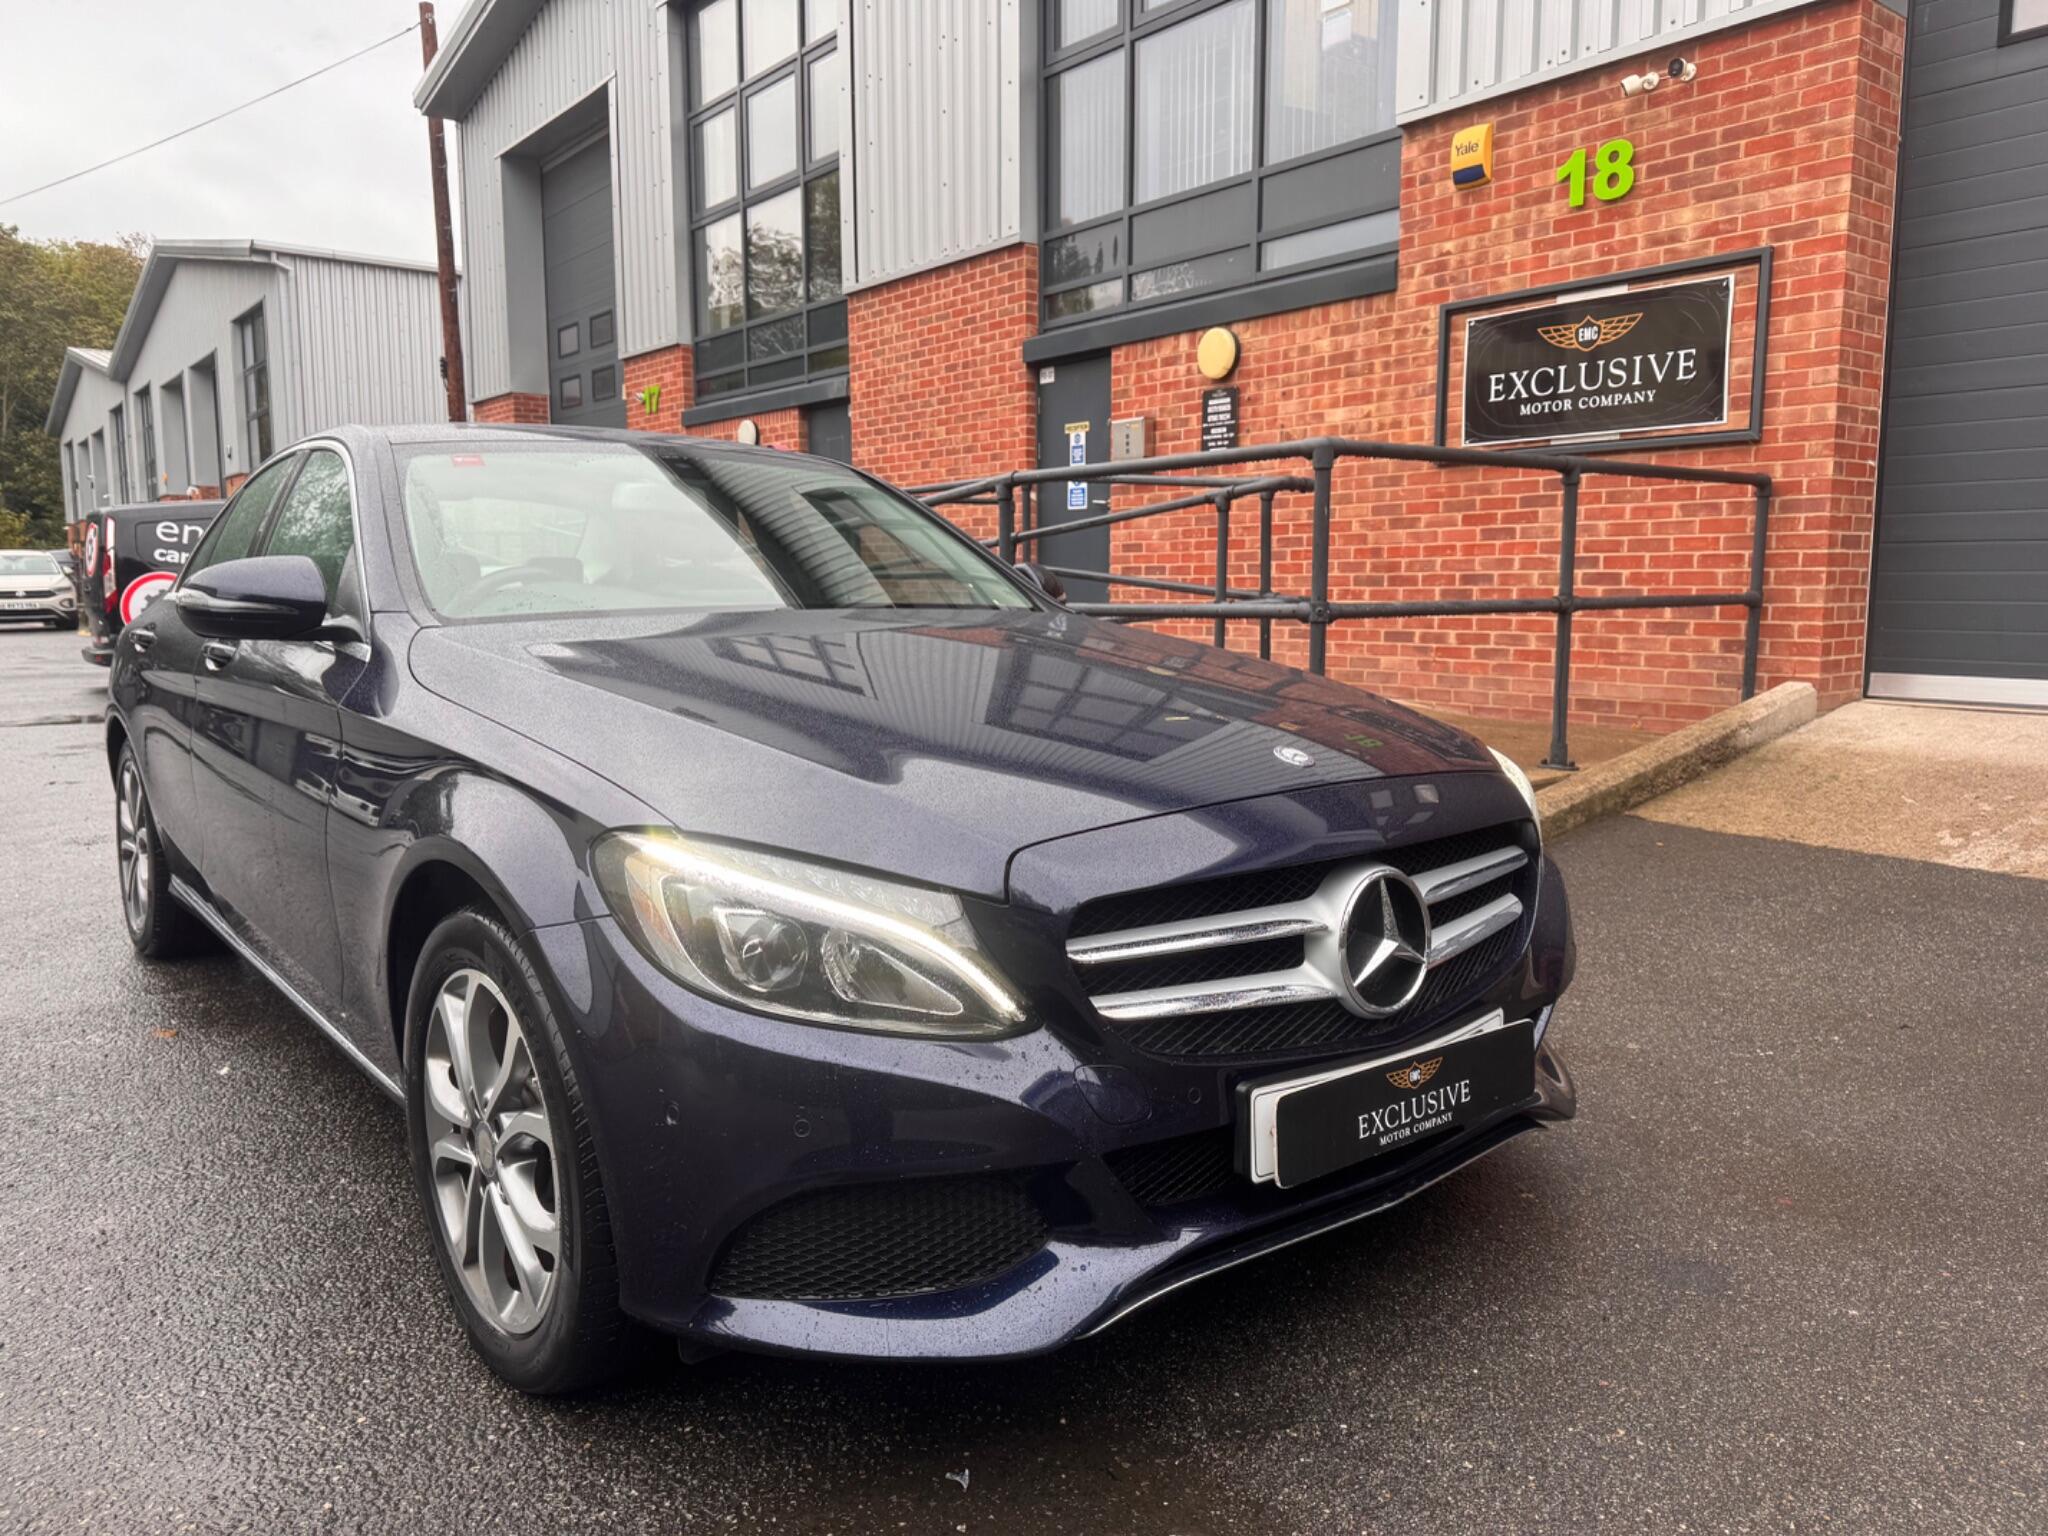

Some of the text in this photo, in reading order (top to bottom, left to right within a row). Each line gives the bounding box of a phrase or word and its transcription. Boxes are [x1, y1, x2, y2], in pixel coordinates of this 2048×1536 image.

[1455, 141, 1479, 157] Yale
[1557, 139, 1635, 207] 18
[1578, 326, 1599, 343] EMC
[1488, 348, 1698, 403] EXCLUSIVE
[642, 384, 661, 416] 17
[1520, 389, 1656, 416] MOTOR COMPANY
[1358, 1079, 1471, 1139] EXCLUSIVE
[1379, 1112, 1453, 1146] MOTOR COMPANY
